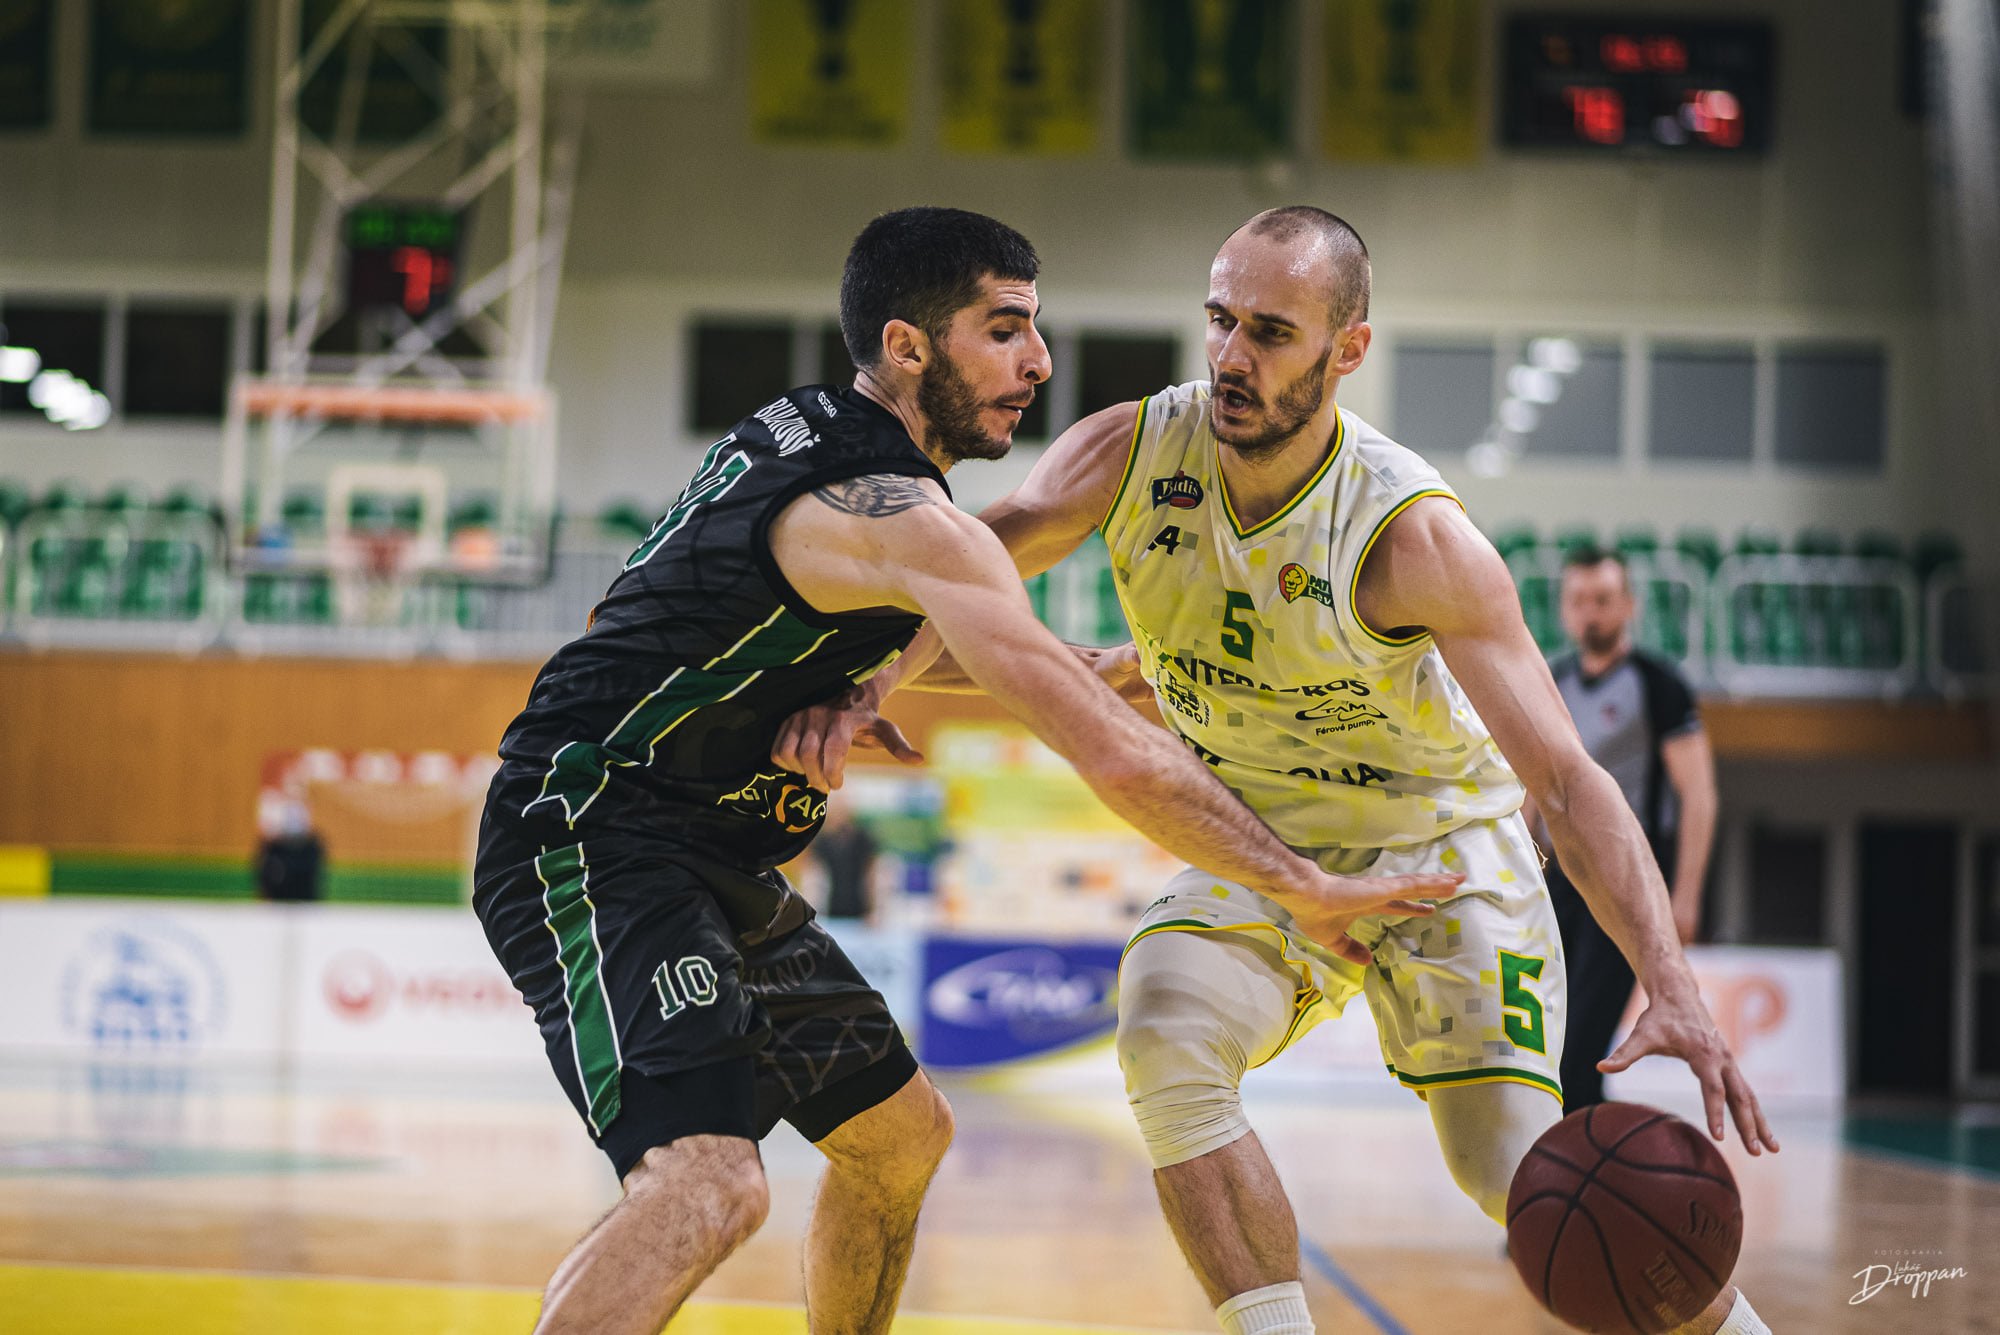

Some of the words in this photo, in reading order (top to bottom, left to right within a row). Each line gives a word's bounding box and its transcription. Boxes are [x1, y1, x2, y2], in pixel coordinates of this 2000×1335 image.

[1220, 589, 1258, 663] 5
[1315, 722, 1346, 736] Férové
[650, 955, 719, 1021] 10
[1497, 947, 1547, 1057] 5
